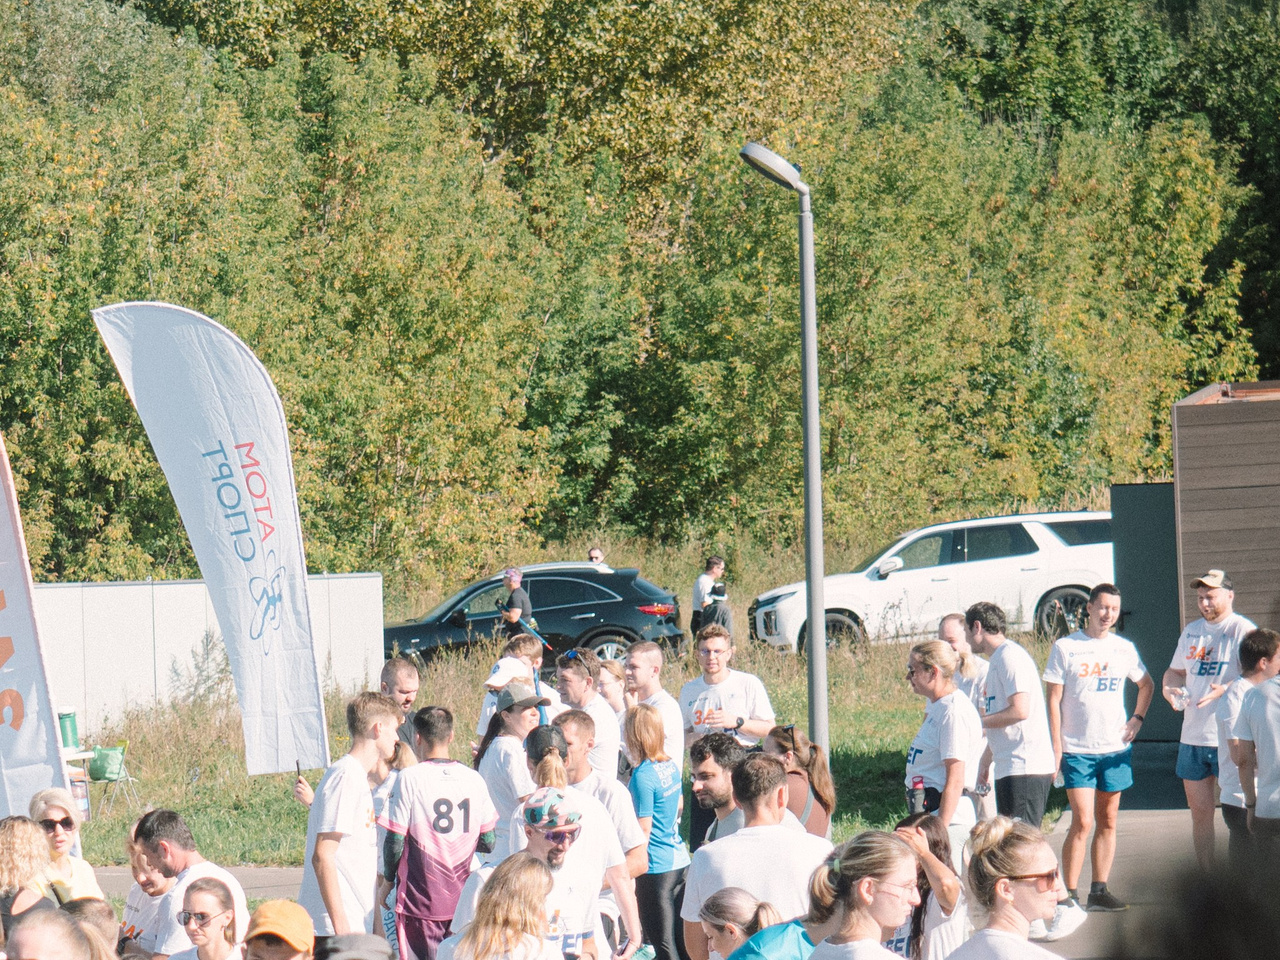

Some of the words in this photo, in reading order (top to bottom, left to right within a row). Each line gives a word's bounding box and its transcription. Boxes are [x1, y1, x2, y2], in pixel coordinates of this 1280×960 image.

[1197, 661, 1229, 676] БЕГ
[906, 747, 923, 765] ЕГ
[432, 797, 470, 834] 81
